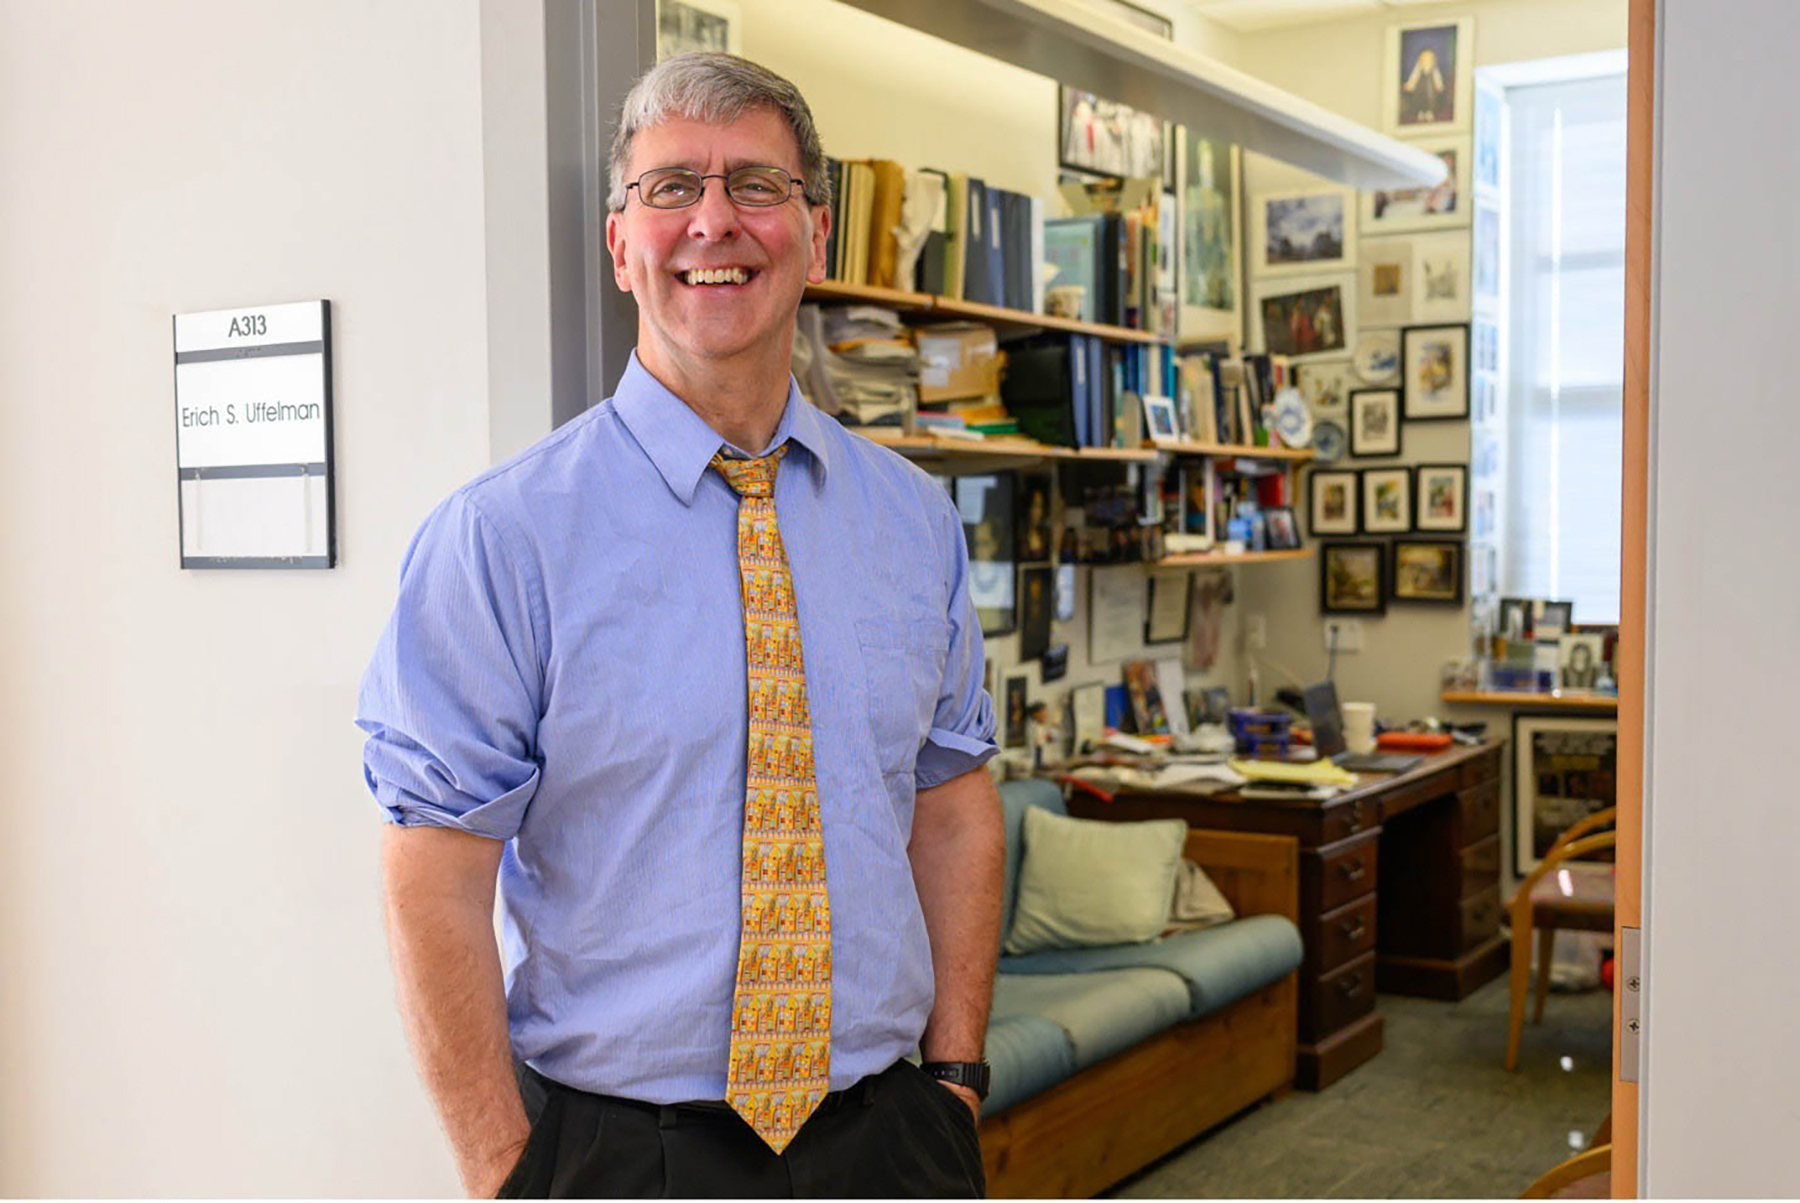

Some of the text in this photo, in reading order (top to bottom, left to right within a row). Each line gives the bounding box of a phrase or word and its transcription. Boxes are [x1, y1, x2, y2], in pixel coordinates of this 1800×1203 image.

[228, 314, 267, 338] A313
[182, 400, 320, 427] Erich S. Uffelman
